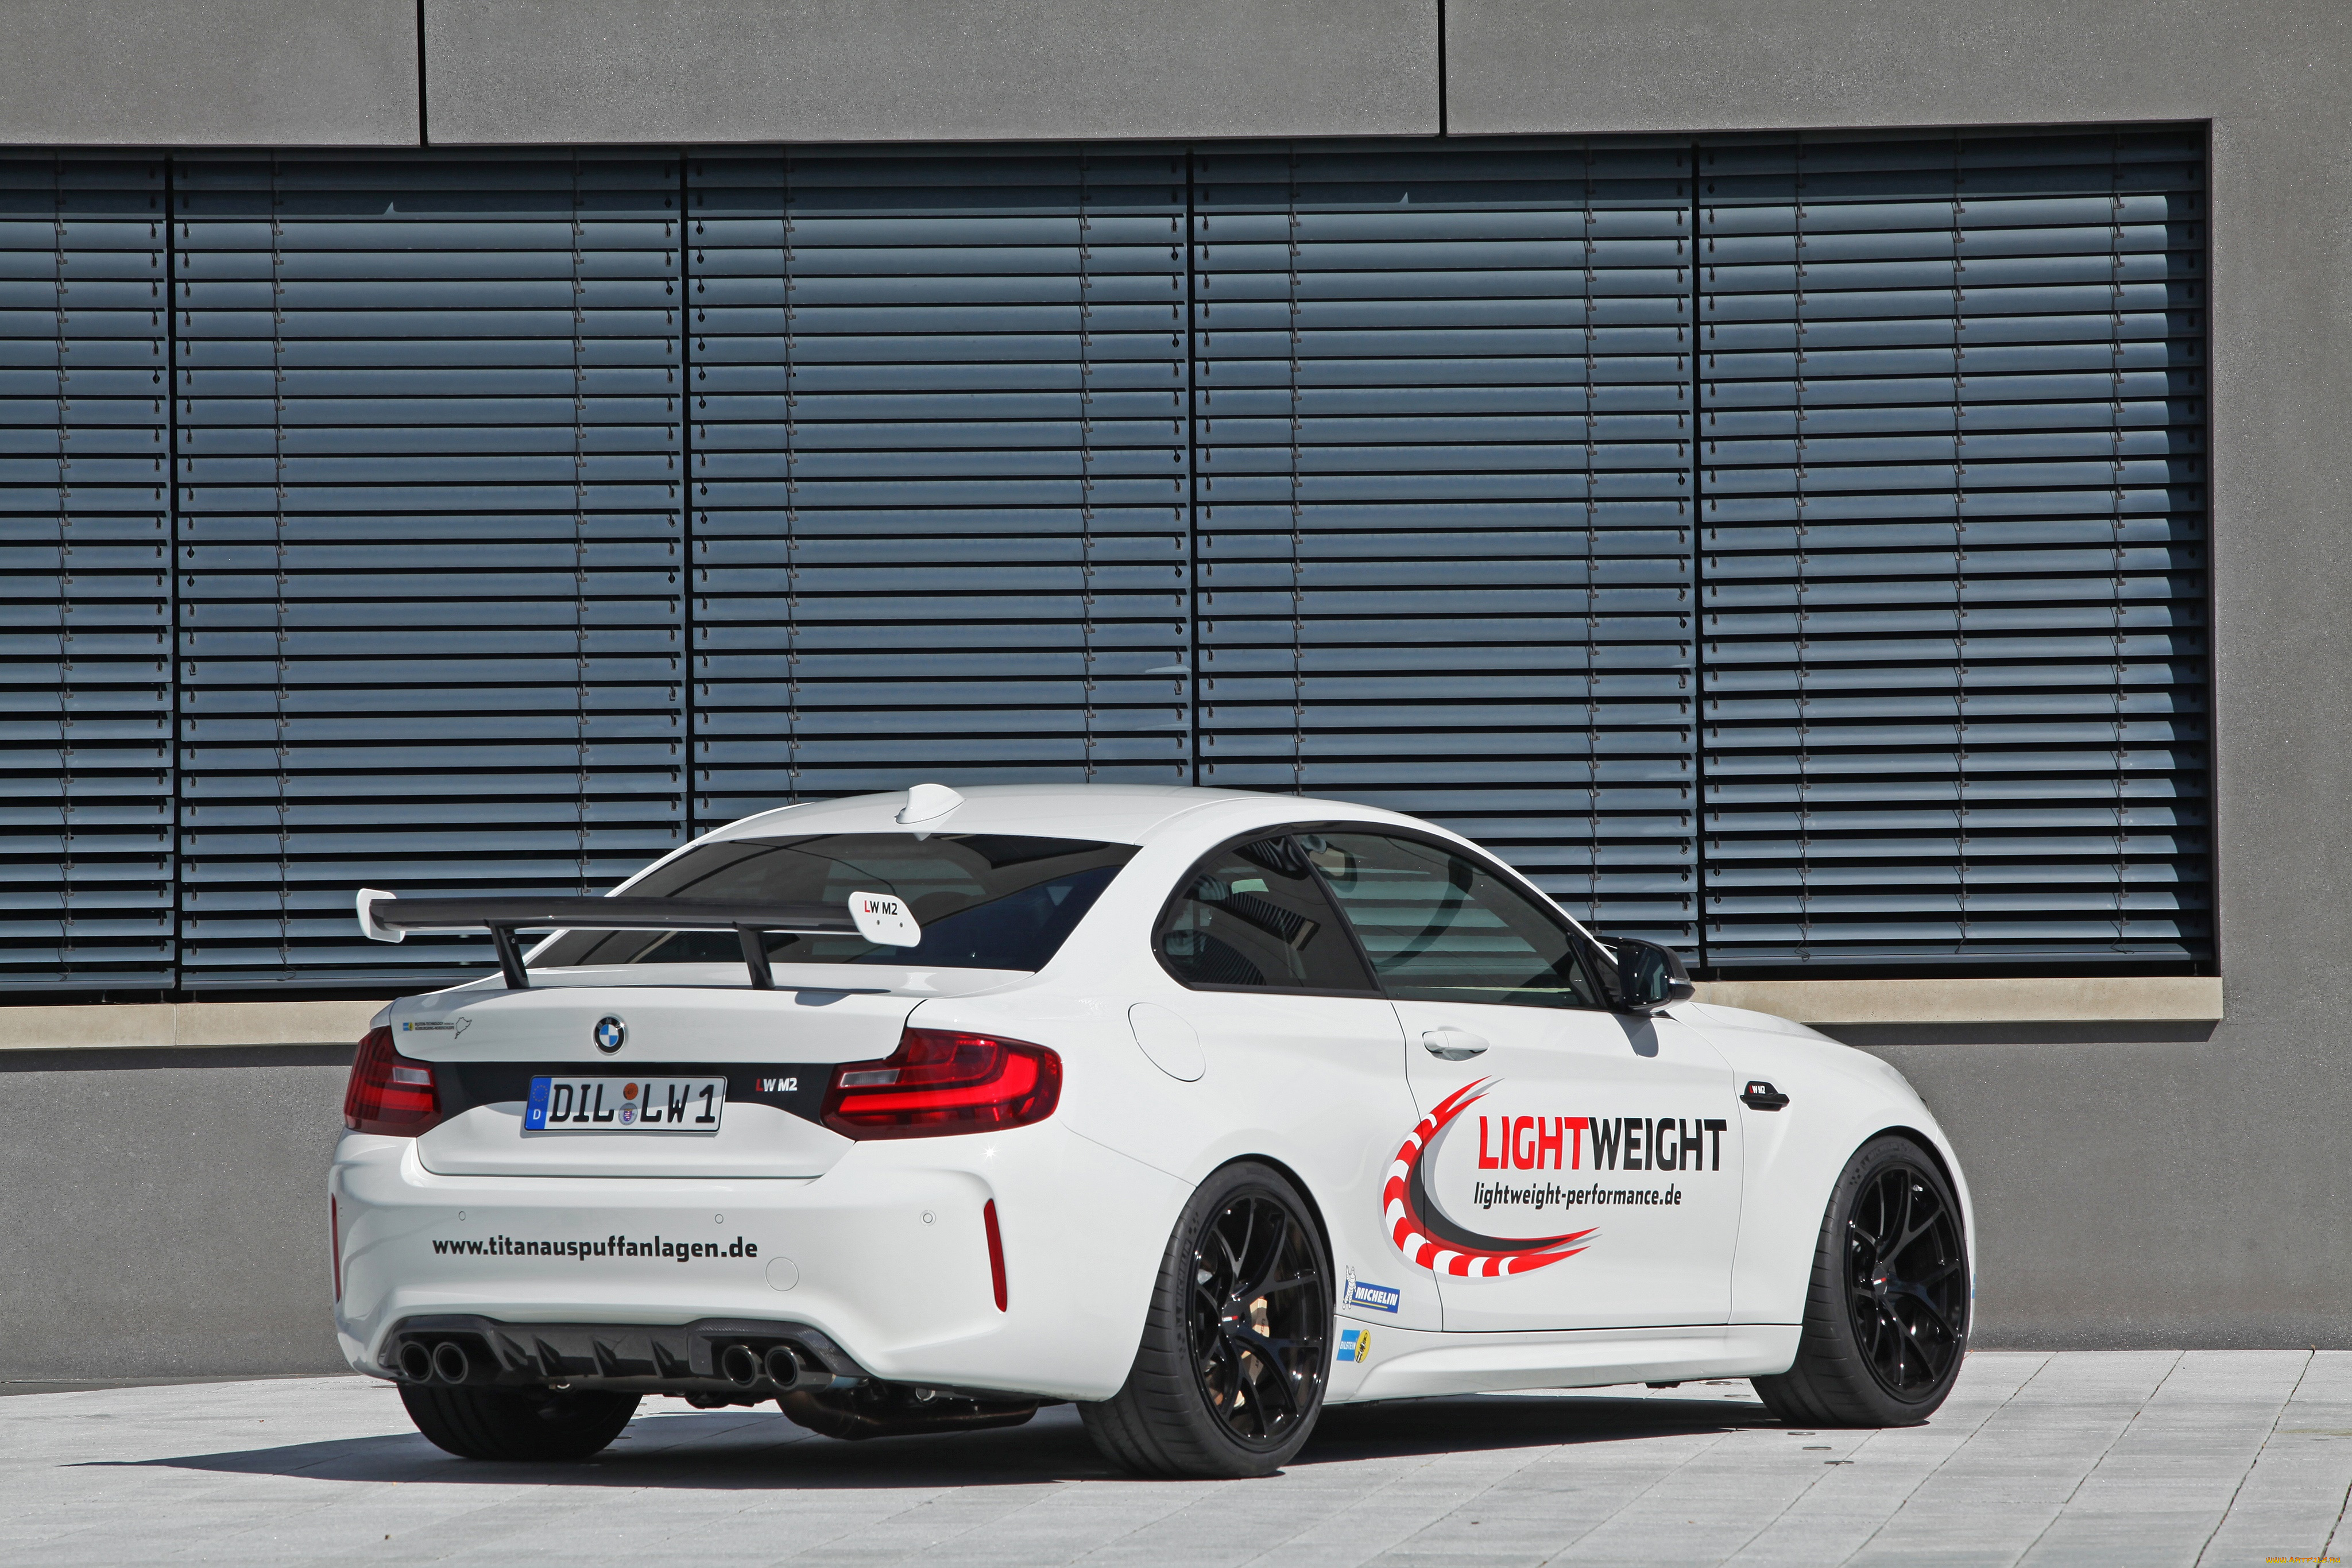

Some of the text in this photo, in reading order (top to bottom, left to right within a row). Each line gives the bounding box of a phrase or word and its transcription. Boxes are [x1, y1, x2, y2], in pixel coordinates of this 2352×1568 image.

[864, 900, 898, 916] LW M2
[756, 1077, 798, 1092] LW M2
[1748, 1085, 1766, 1094] LW M2
[549, 1083, 615, 1122] DIL
[532, 1109, 541, 1120] D
[1477, 1116, 1727, 1171] LIGHTWEIGHT
[1473, 1181, 1682, 1210] lightweight-performance.de
[432, 1234, 759, 1263] www.titanauspuffanlagen.de
[1355, 1286, 1398, 1306] MICHELIN
[1340, 1341, 1356, 1350] BILSTEIN
